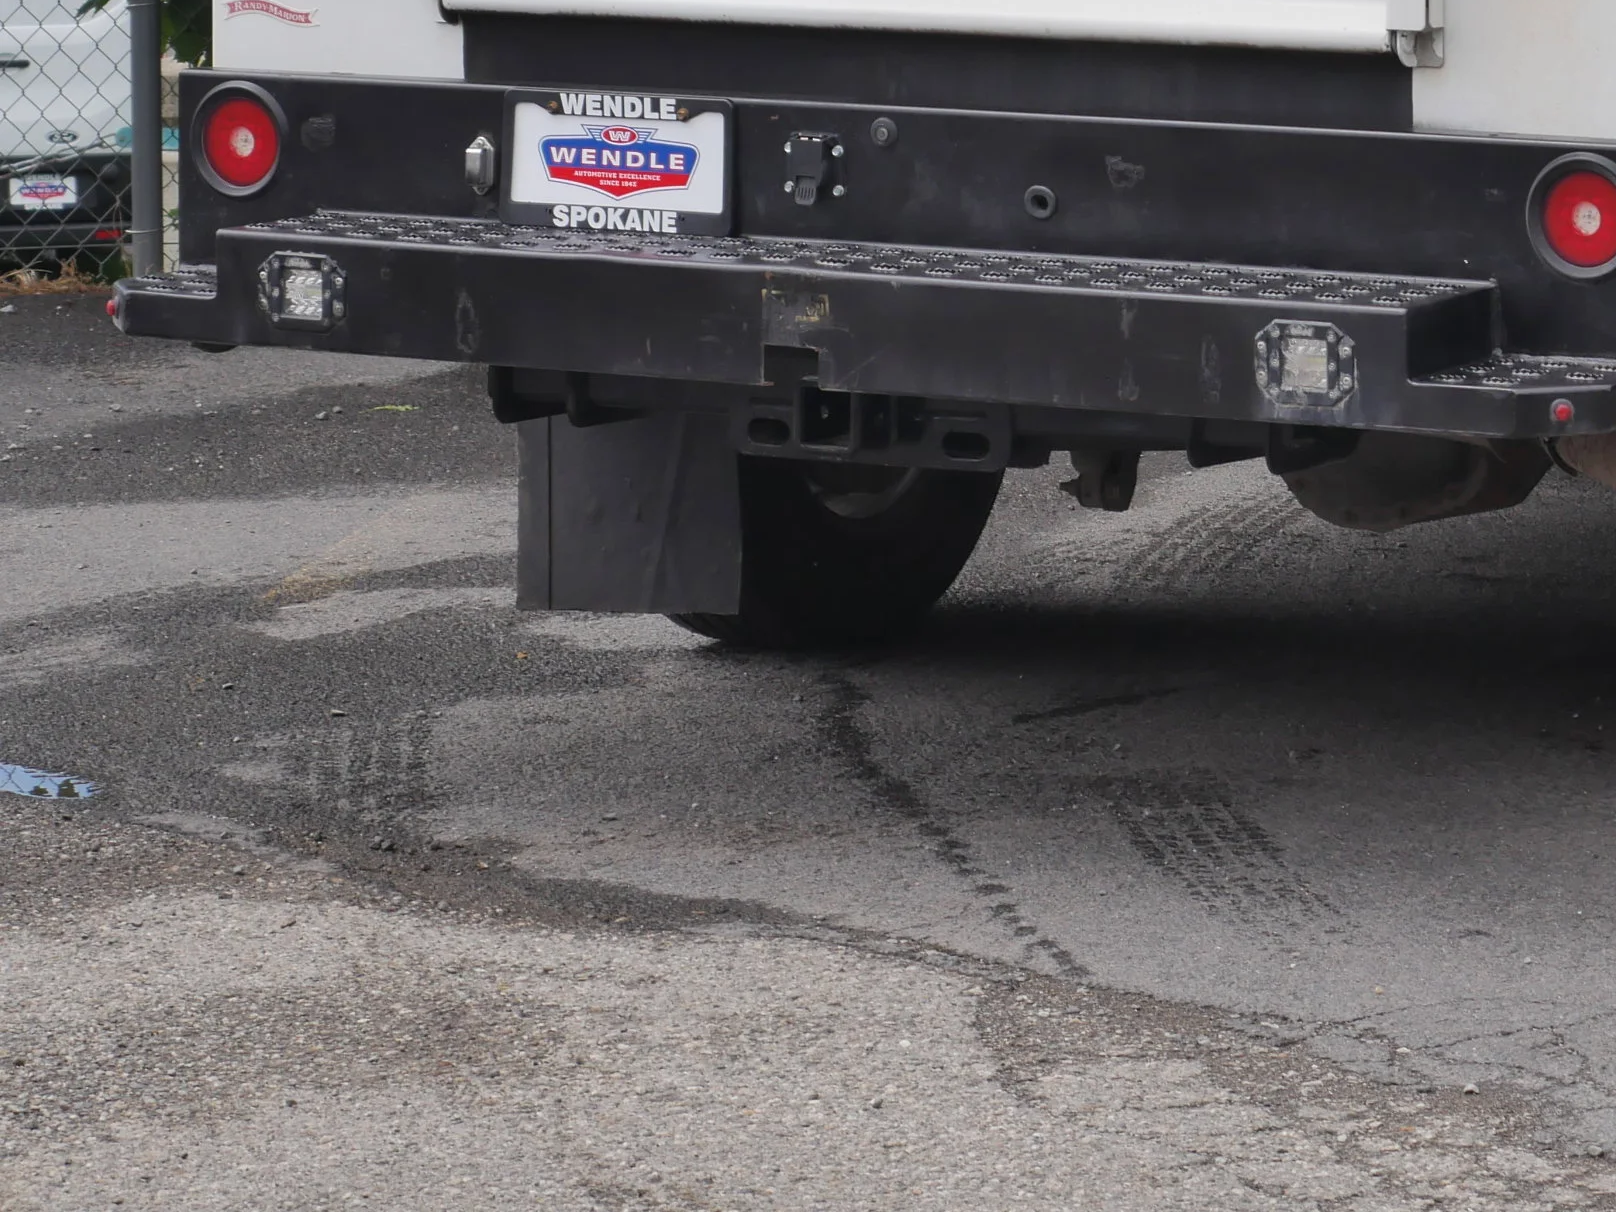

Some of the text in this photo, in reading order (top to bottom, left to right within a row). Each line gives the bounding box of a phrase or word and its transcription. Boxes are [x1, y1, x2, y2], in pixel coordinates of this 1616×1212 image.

[560, 93, 677, 121] WENDLE
[550, 146, 685, 170] WENDLE
[574, 170, 661, 181] AUTOMOTIVE EXCELLENCE
[552, 205, 677, 233] SPOKANE
